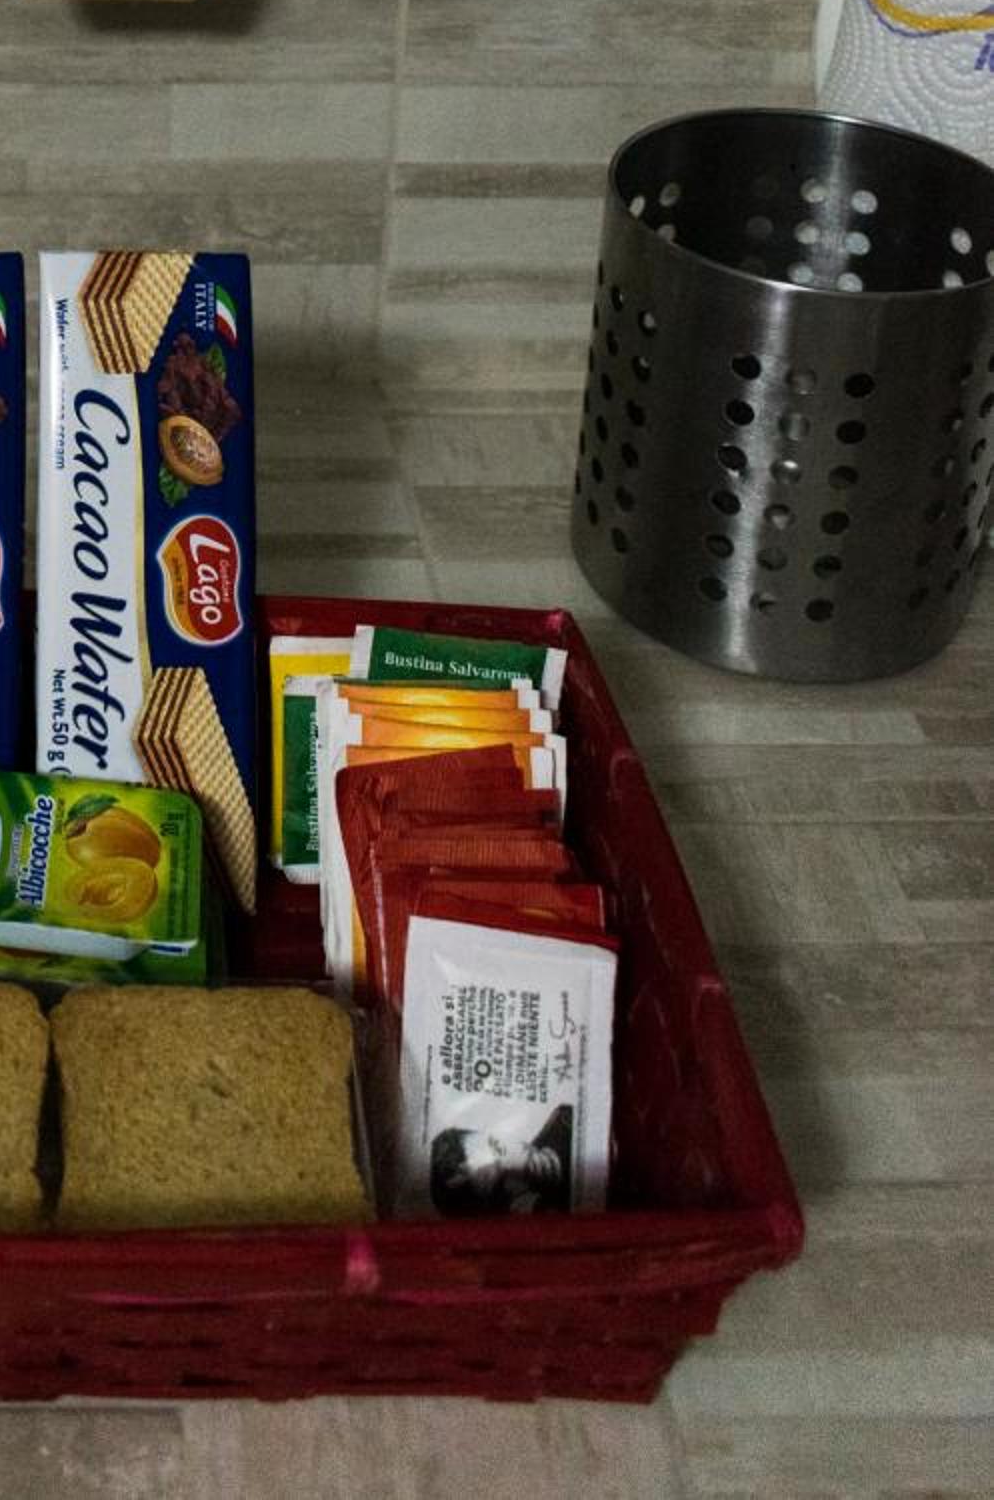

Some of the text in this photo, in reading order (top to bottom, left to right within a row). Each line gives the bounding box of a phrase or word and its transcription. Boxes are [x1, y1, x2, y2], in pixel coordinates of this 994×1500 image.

[56, 299, 68, 339] Wafer
[194, 283, 206, 331] ITALY
[68, 389, 133, 769] Cacao Wafer
[190, 534, 230, 624] Lago
[53, 669, 65, 692] Net
[385, 652, 444, 672] Bustina
[47, 751, 65, 761] g
[306, 797, 319, 851] Bustina
[17, 796, 54, 907] Albicocche
[439, 996, 454, 1085] e allora si
[528, 993, 539, 1047] NIENTE
[515, 1022, 526, 1084] DIMANE
